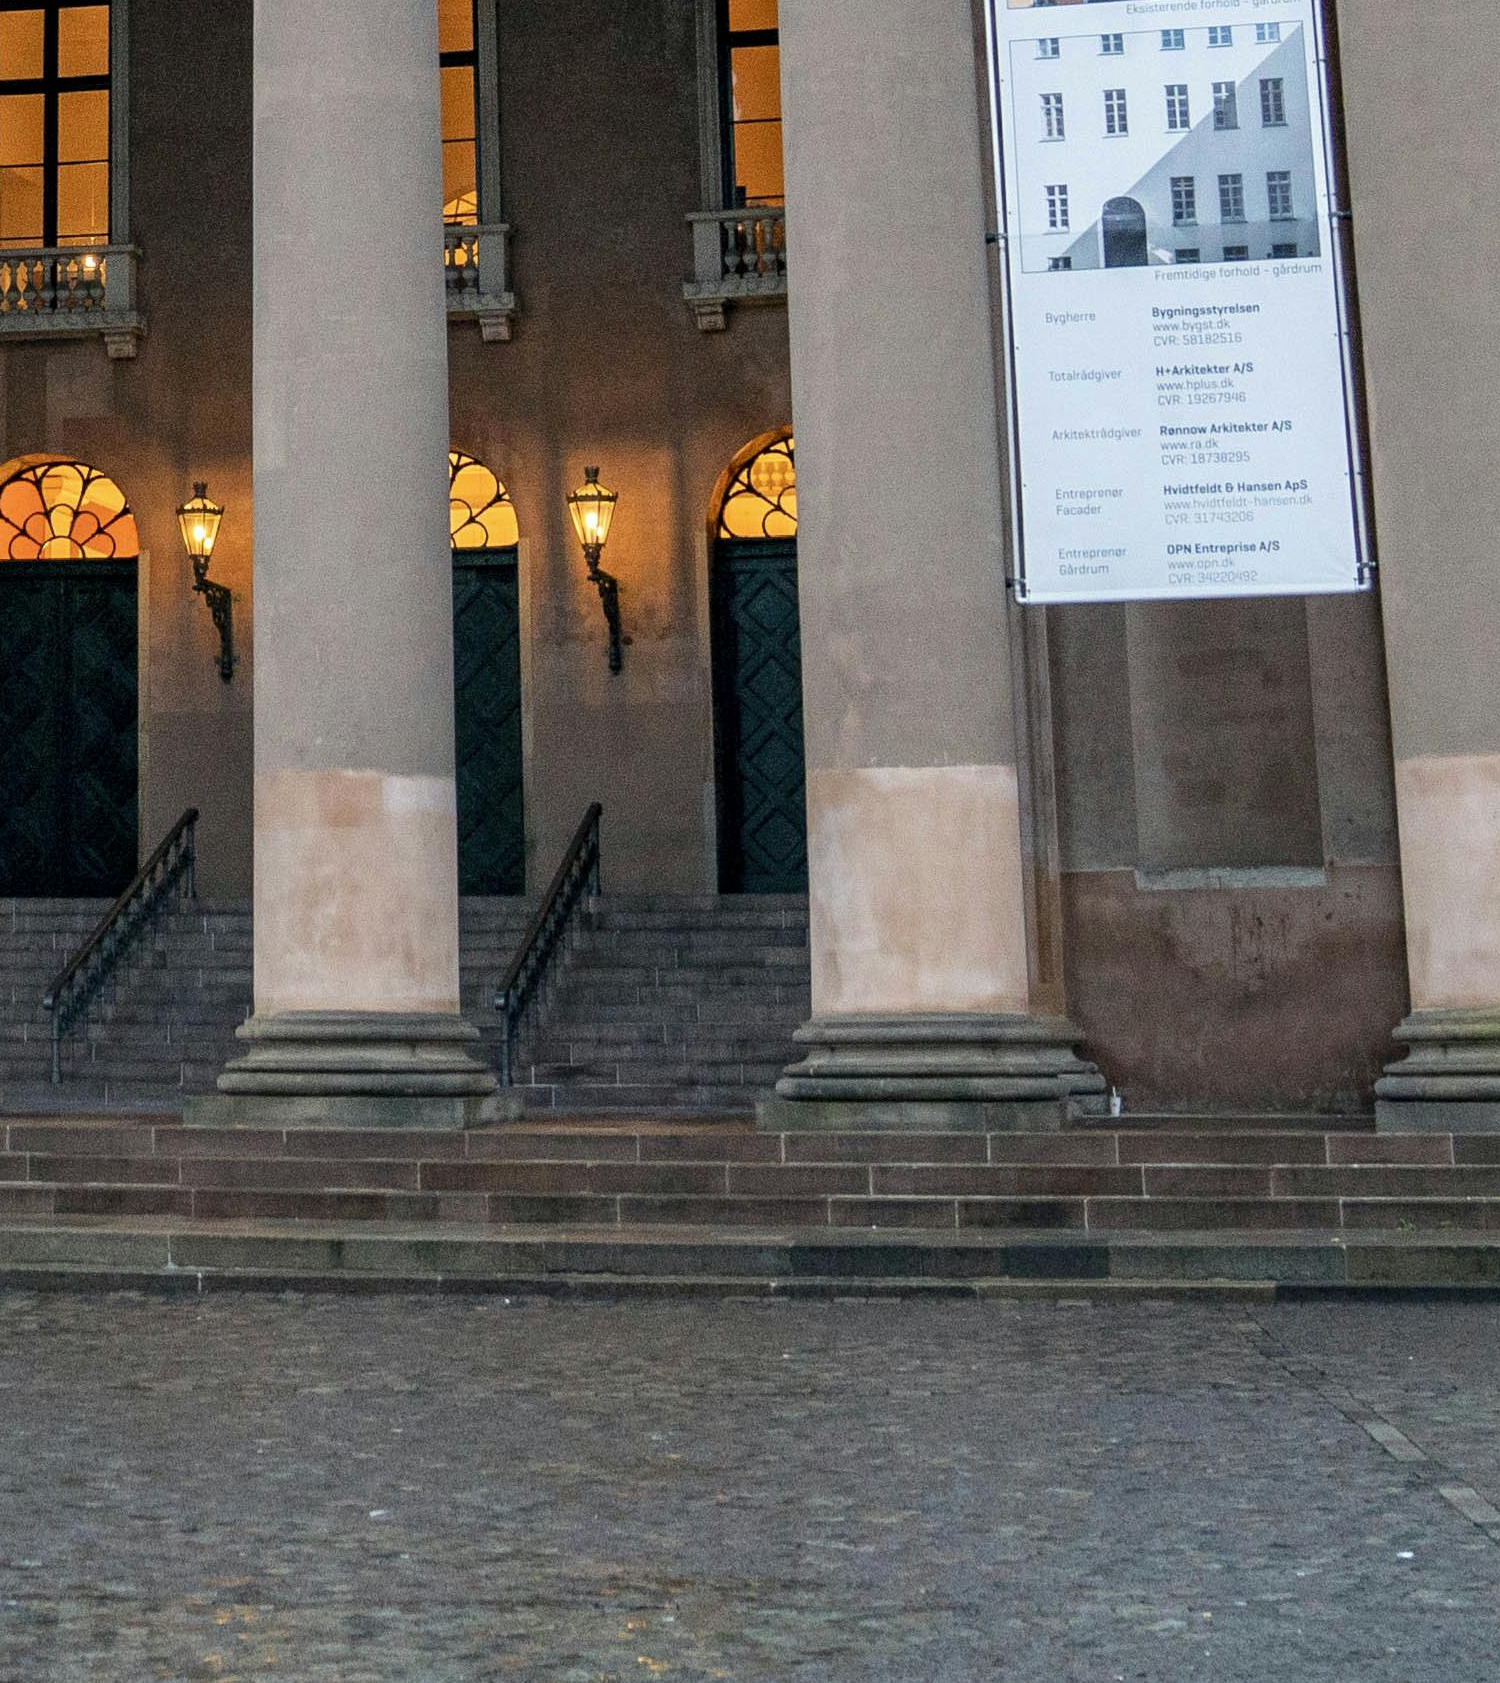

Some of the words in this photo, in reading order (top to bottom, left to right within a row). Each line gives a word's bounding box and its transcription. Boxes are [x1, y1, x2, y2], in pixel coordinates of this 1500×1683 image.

[1126, 0, 1197, 15] Eksisterende
[1154, 269, 1217, 282] Fremtidige
[1219, 265, 1260, 278] forhold
[1272, 263, 1322, 278] gårdrum
[1045, 311, 1096, 325] Bygherre
[1152, 303, 1260, 319] Bygningsstyrelsen
[1152, 318, 1231, 333] www.bygst.dk
[1048, 369, 1122, 383] Totalrådgiver
[1156, 363, 1230, 377] H+Arkitekter
[1233, 361, 1254, 374] A/S
[1156, 378, 1234, 392] www.hplus.dk
[1052, 427, 1142, 441] Arkitektrådgiver
[1159, 424, 1207, 436] Rønnow
[1210, 422, 1269, 434] Arkitekter
[1271, 420, 1293, 433] A/S
[1160, 439, 1219, 451] www.ra.dk
[1055, 487, 1124, 501] Entreprenør
[1163, 483, 1222, 496] Hvidtfeldt
[1225, 482, 1234, 493] &
[1237, 481, 1282, 493] Hansen
[1284, 479, 1308, 493] ApS
[1056, 504, 1102, 516] Facader
[1058, 548, 1127, 561] Entreprenør
[1166, 544, 1192, 555] OPN
[1195, 541, 1256, 556] Entreprise
[1259, 540, 1281, 554] A/S
[1059, 563, 1110, 576] Gårdrum
